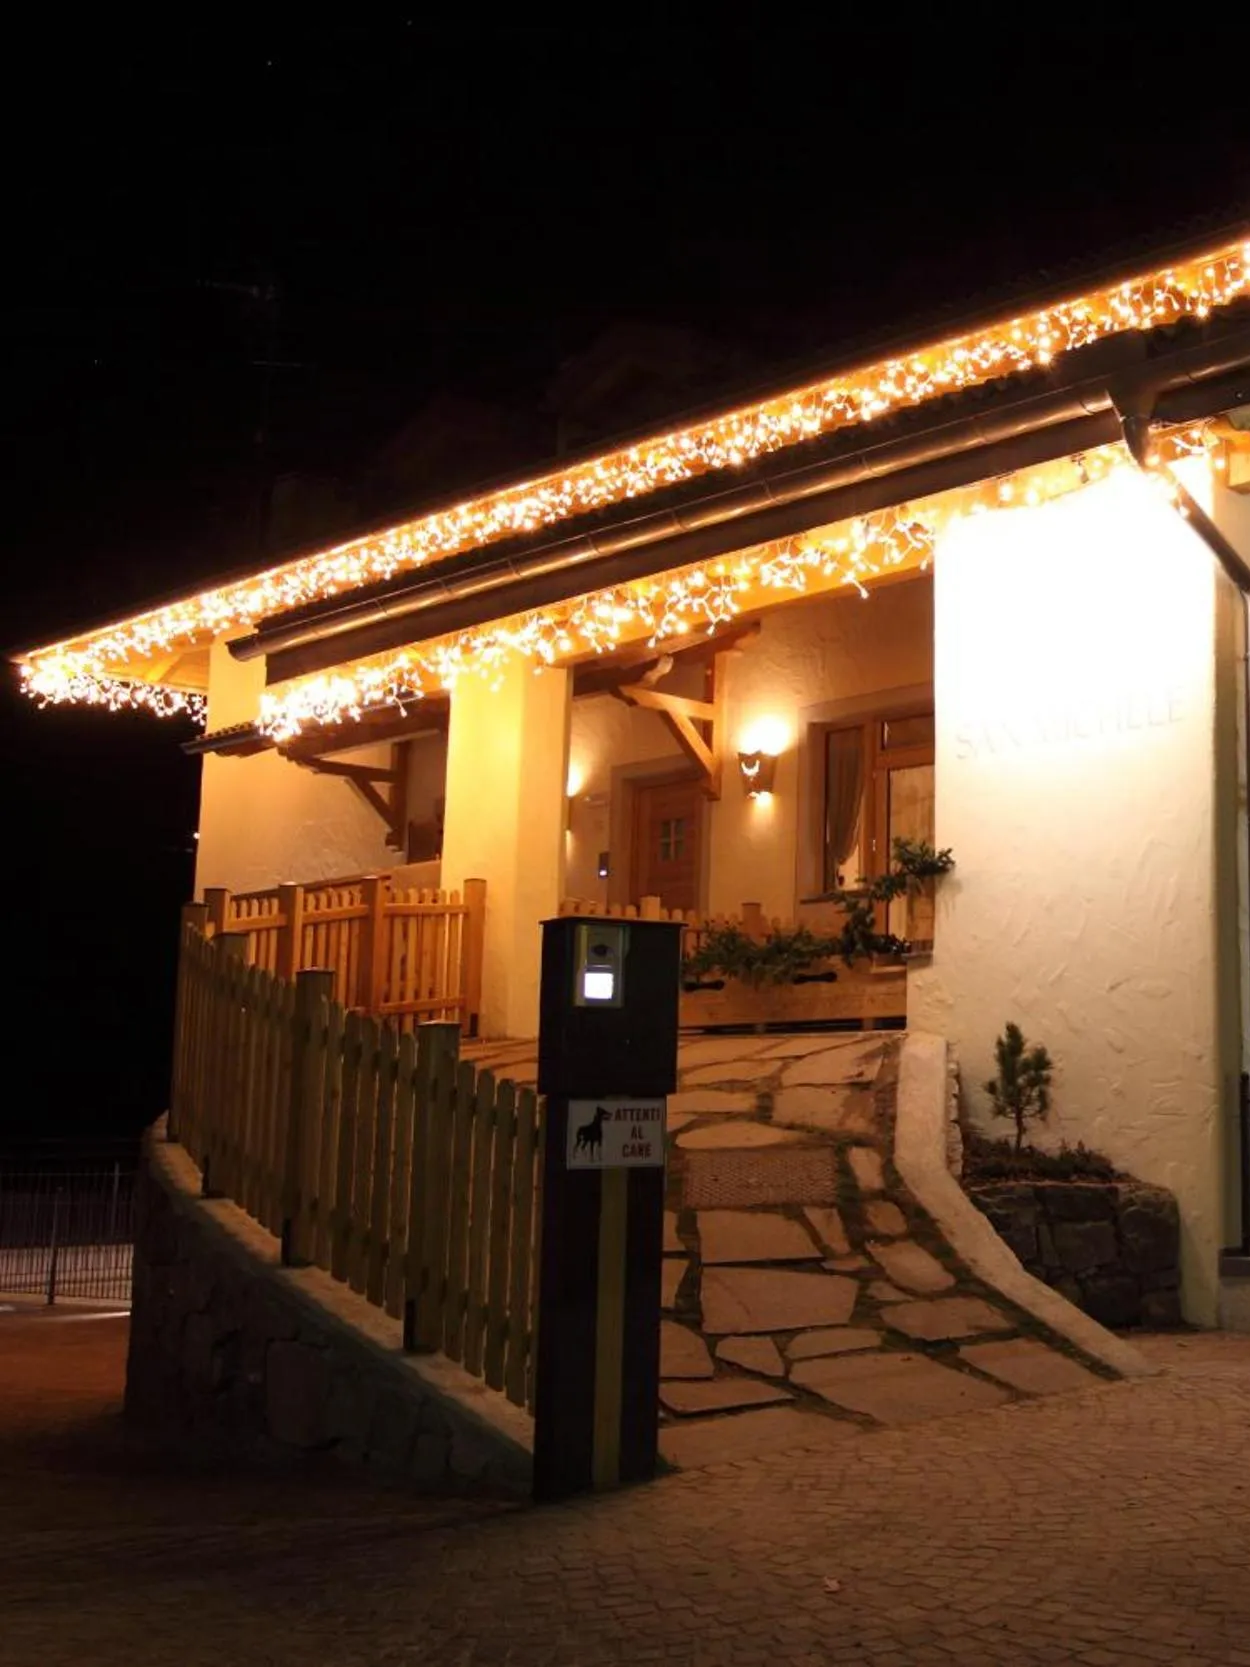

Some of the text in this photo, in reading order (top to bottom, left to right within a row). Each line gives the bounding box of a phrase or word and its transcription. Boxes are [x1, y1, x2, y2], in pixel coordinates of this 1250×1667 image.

[614, 1107, 661, 1122] ATTENTI
[630, 1125, 645, 1140] AL
[622, 1143, 653, 1160] CANE
